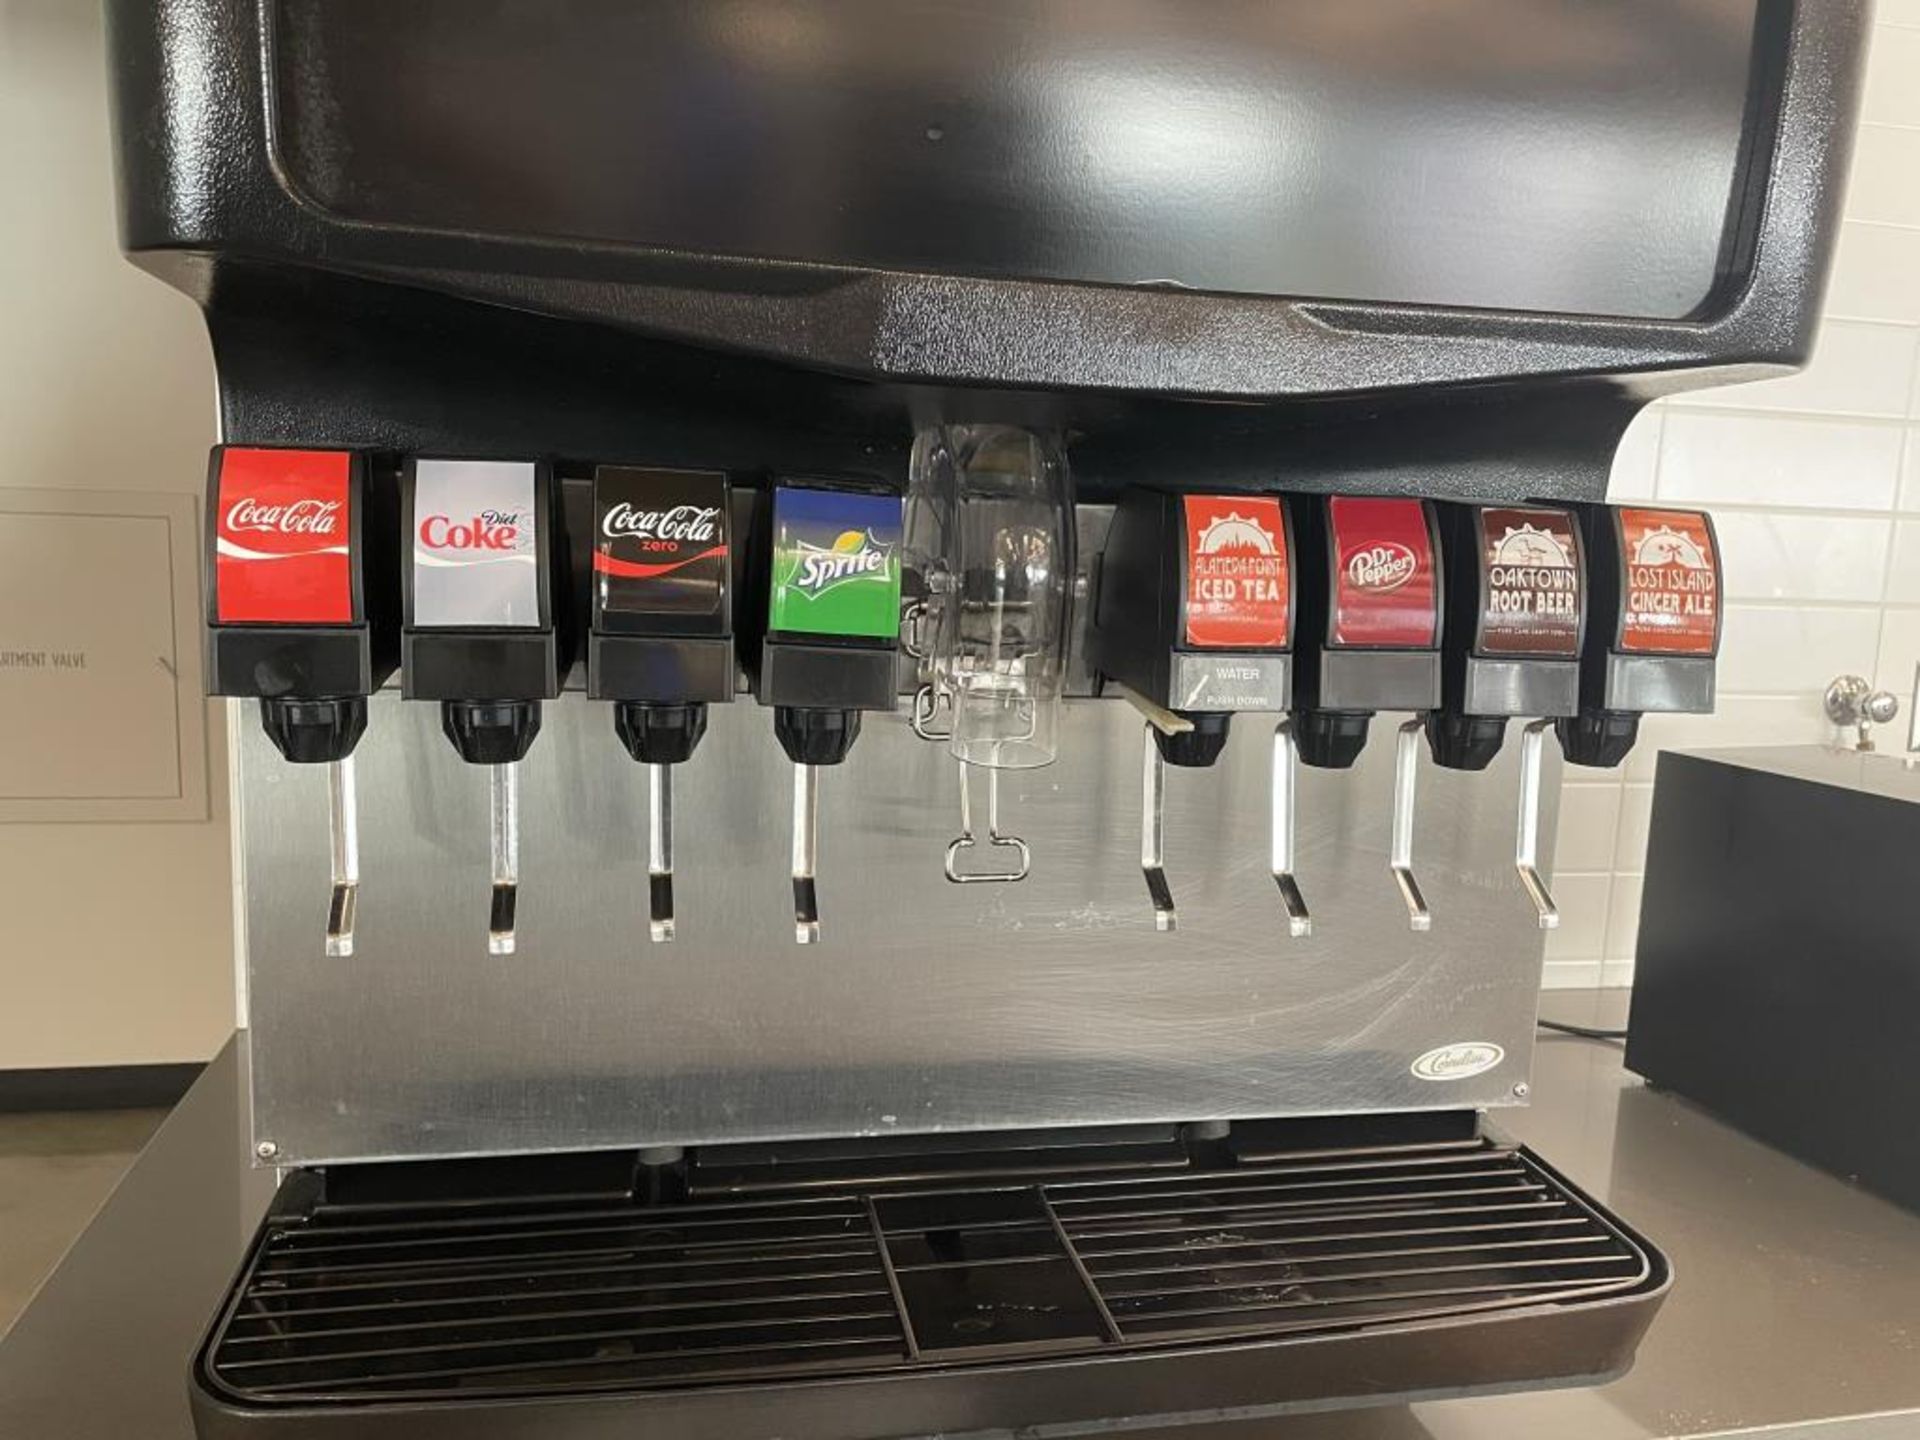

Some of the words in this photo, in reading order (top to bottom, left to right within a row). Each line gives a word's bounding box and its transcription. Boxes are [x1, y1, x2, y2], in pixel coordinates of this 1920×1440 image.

[226, 498, 342, 534] Coca-Cola
[481, 510, 518, 525] Diet
[602, 502, 721, 541] Coca-Cola
[420, 516, 517, 550] Coke
[641, 540, 678, 552] zero
[1372, 547, 1395, 566] Dr
[798, 542, 882, 589] Sprite
[1349, 552, 1411, 586] Pepper
[1195, 578, 1236, 600] ICED
[1242, 579, 1280, 601] TEA
[1490, 567, 1577, 591] OAKTOWN
[1628, 567, 1664, 588] LOST
[1667, 569, 1714, 593] ISLAND
[1489, 590, 1532, 613] ROOT
[1536, 592, 1575, 614] BEER
[1630, 591, 1680, 614] GINGER
[1684, 594, 1713, 615] ALE
[0, 652, 46, 668] RTMENT
[51, 653, 87, 668] VALVE
[1216, 667, 1260, 681] WATER
